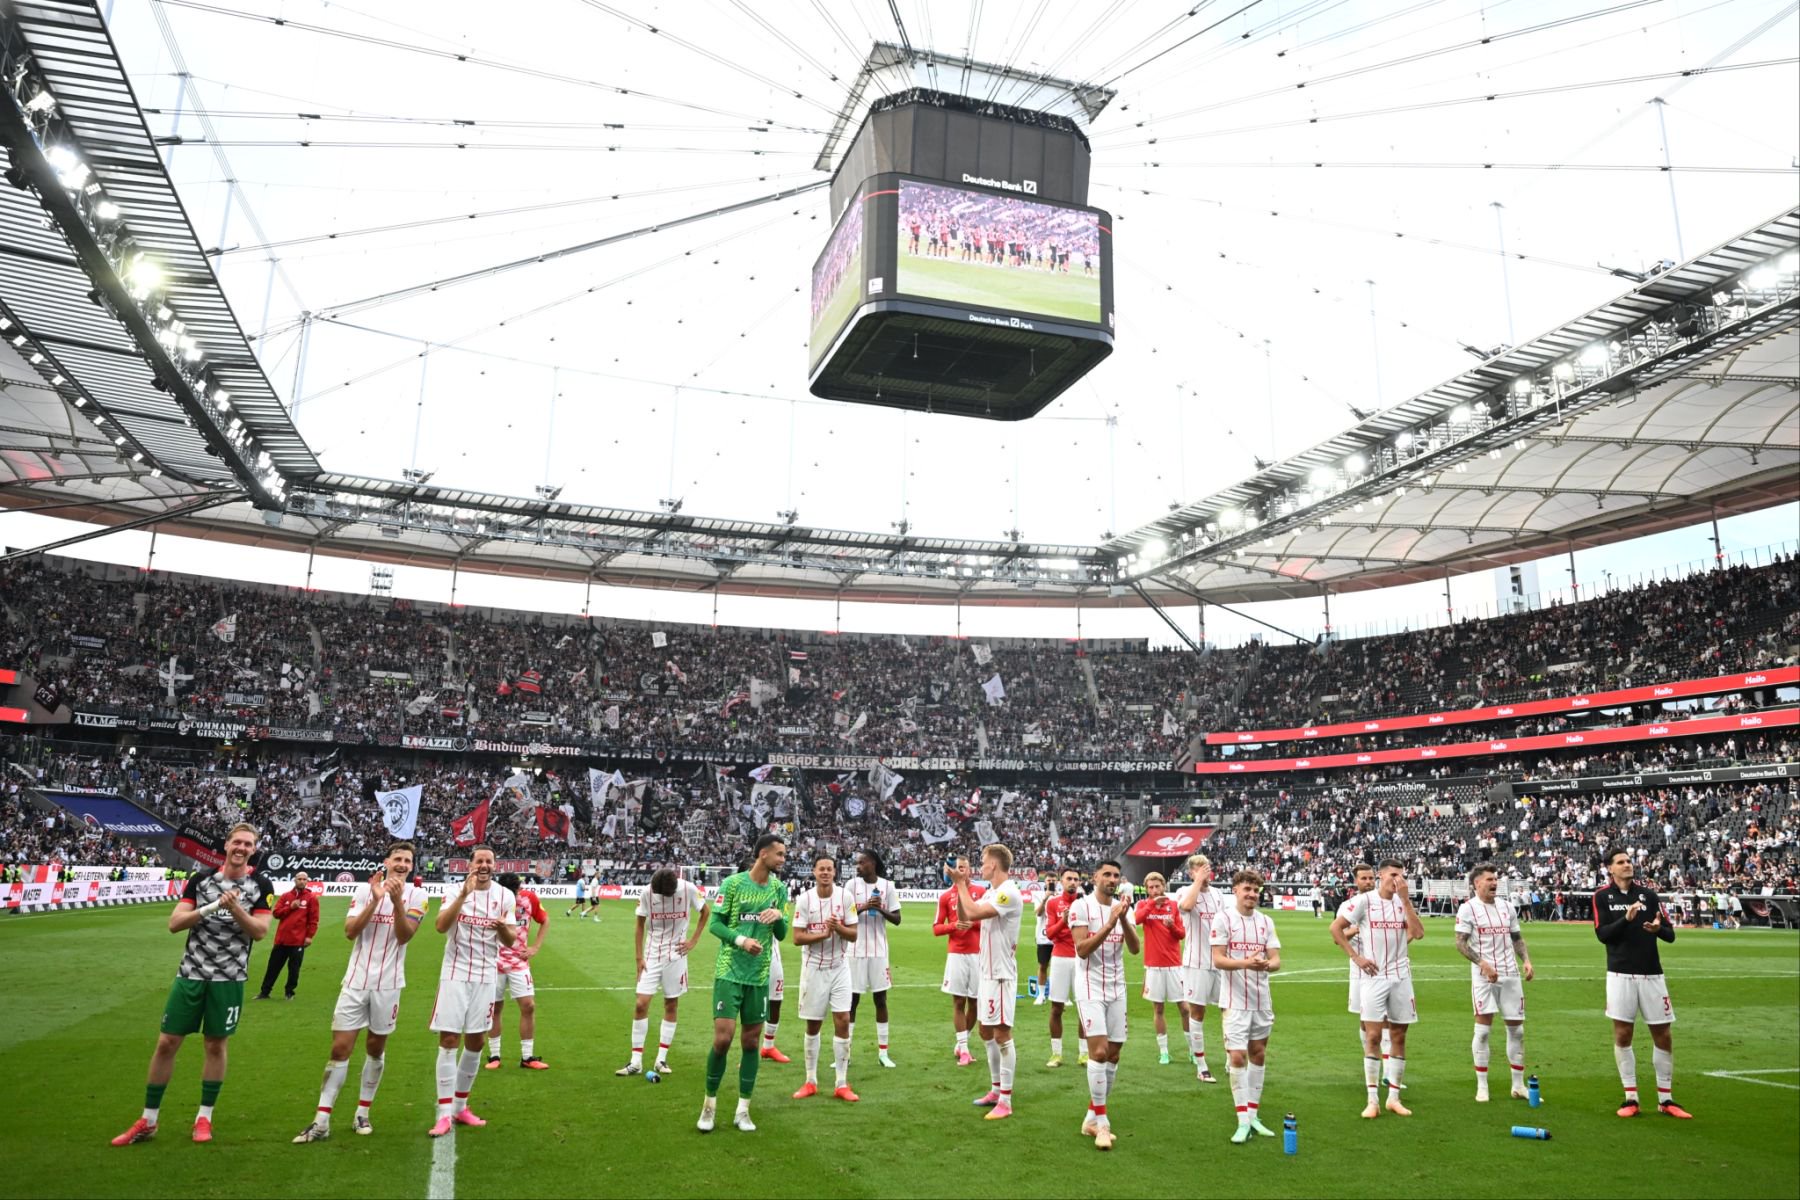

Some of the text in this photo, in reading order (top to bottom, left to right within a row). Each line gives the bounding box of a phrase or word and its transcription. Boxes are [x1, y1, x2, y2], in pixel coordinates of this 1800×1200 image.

[963, 173, 1023, 192] Deutsche Bank
[969, 314, 995, 324] Deutsche
[1020, 322, 1034, 330] Park
[191, 721, 246, 732] COMMANDO
[197, 731, 239, 739] GIESSEN
[402, 736, 452, 748] RAGAZZI
[475, 739, 581, 756] Binding Szene
[768, 755, 820, 766] BRIGADE
[1130, 761, 1173, 772] SEMPRE
[184, 827, 214, 846] EINTRACHT
[449, 858, 531, 873] FRAFURT
[653, 912, 684, 920] Lexware
[989, 1000, 995, 1014] 3
[226, 1006, 240, 1024] 21
